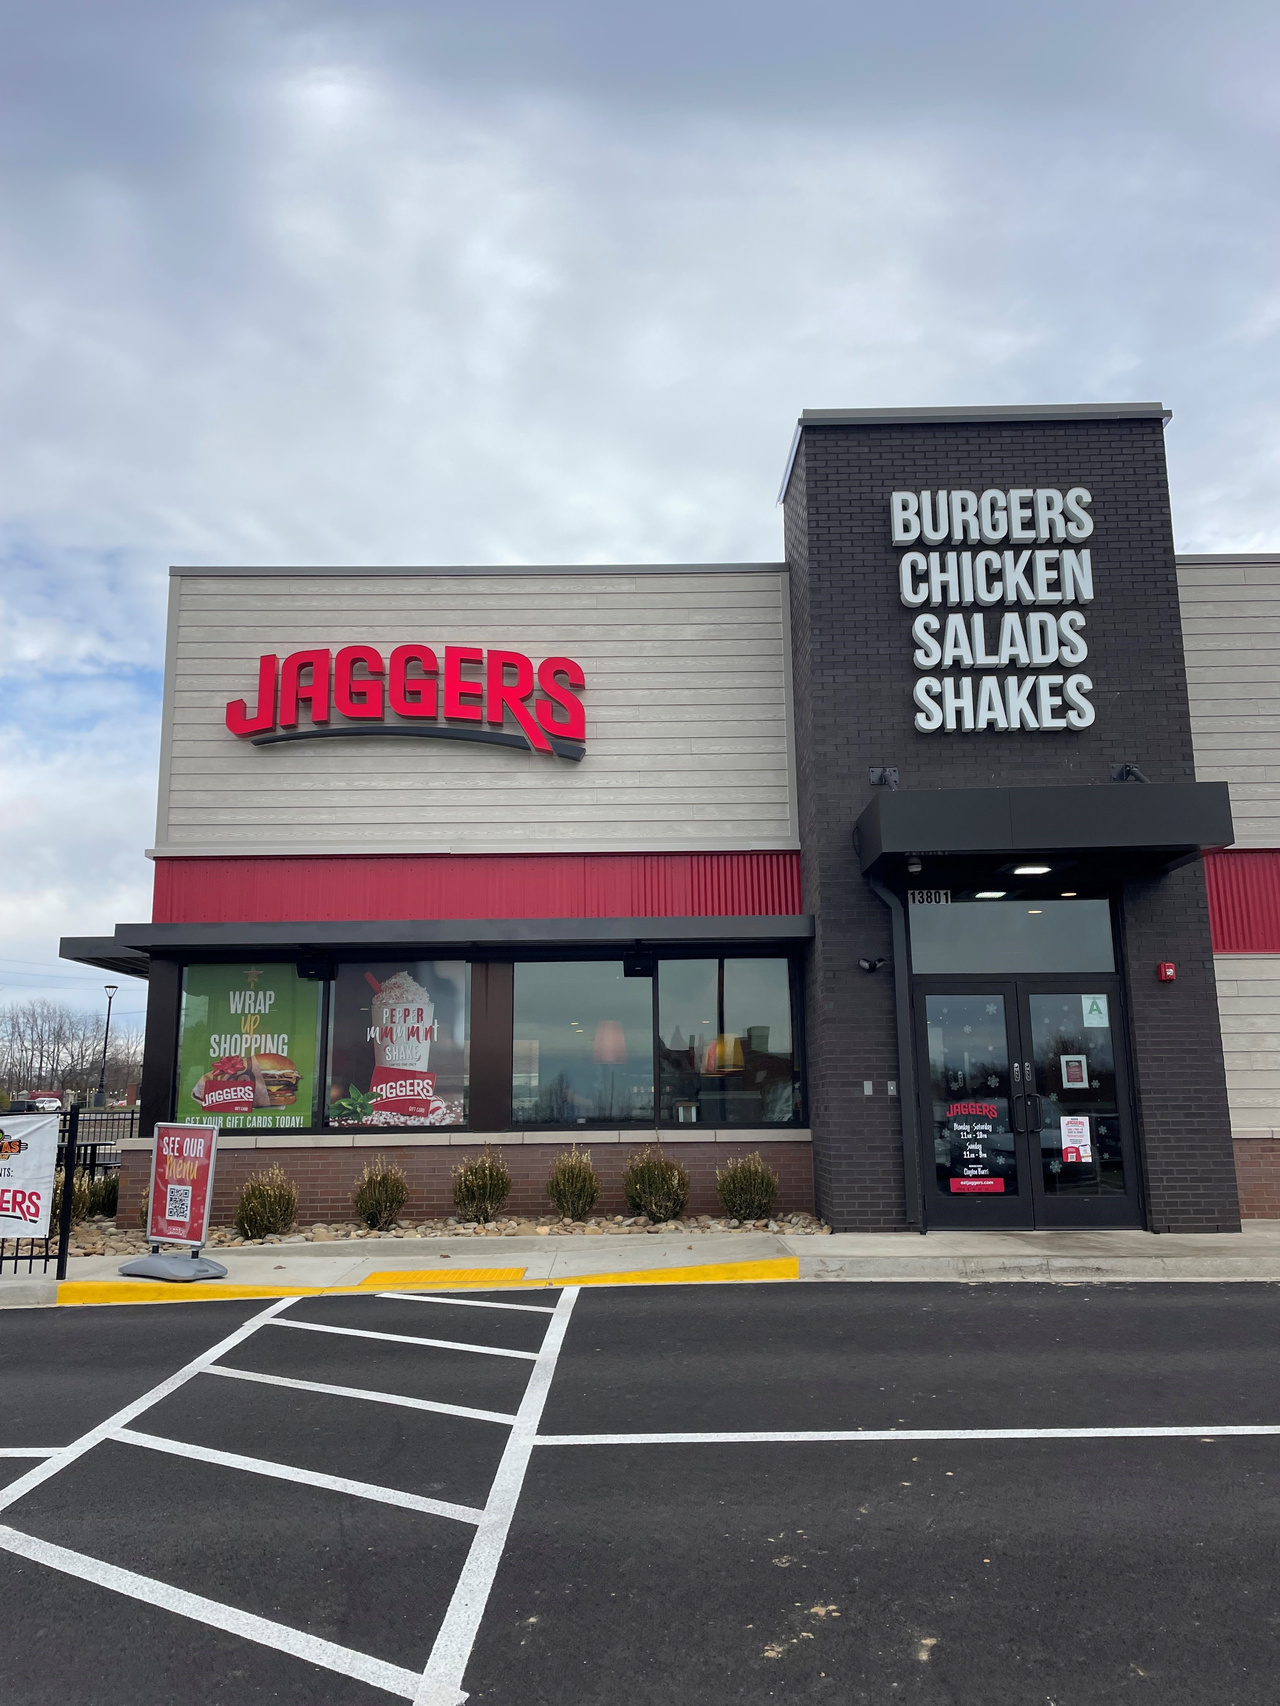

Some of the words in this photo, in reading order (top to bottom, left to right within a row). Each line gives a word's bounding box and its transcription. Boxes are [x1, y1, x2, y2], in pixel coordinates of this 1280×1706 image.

[890, 487, 1094, 546] BURGERS
[899, 549, 1094, 608] CHICKEN
[912, 610, 1088, 670] SALADS
[225, 643, 586, 755] JAGGERS
[913, 674, 1096, 733] SHAKES
[910, 890, 949, 904] 13801
[229, 990, 275, 1014] WRAP
[1088, 1000, 1103, 1015] A
[383, 1007, 424, 1025] PEPPER
[209, 1033, 289, 1057] SHOPPING
[385, 1045, 420, 1062] SHAKE
[202, 1086, 254, 1106] JAGGERS
[946, 1102, 998, 1119] JAGGERS
[185, 1116, 200, 1124] GET
[202, 1116, 224, 1127] YOUR
[226, 1116, 244, 1128] GIFT
[246, 1116, 273, 1128] CARDS
[275, 1116, 304, 1128] TODAY!
[0, 1141, 20, 1153] AS
[162, 1136, 181, 1156] SEE
[182, 1137, 205, 1158] OUR
[0, 1189, 41, 1221] ERS
